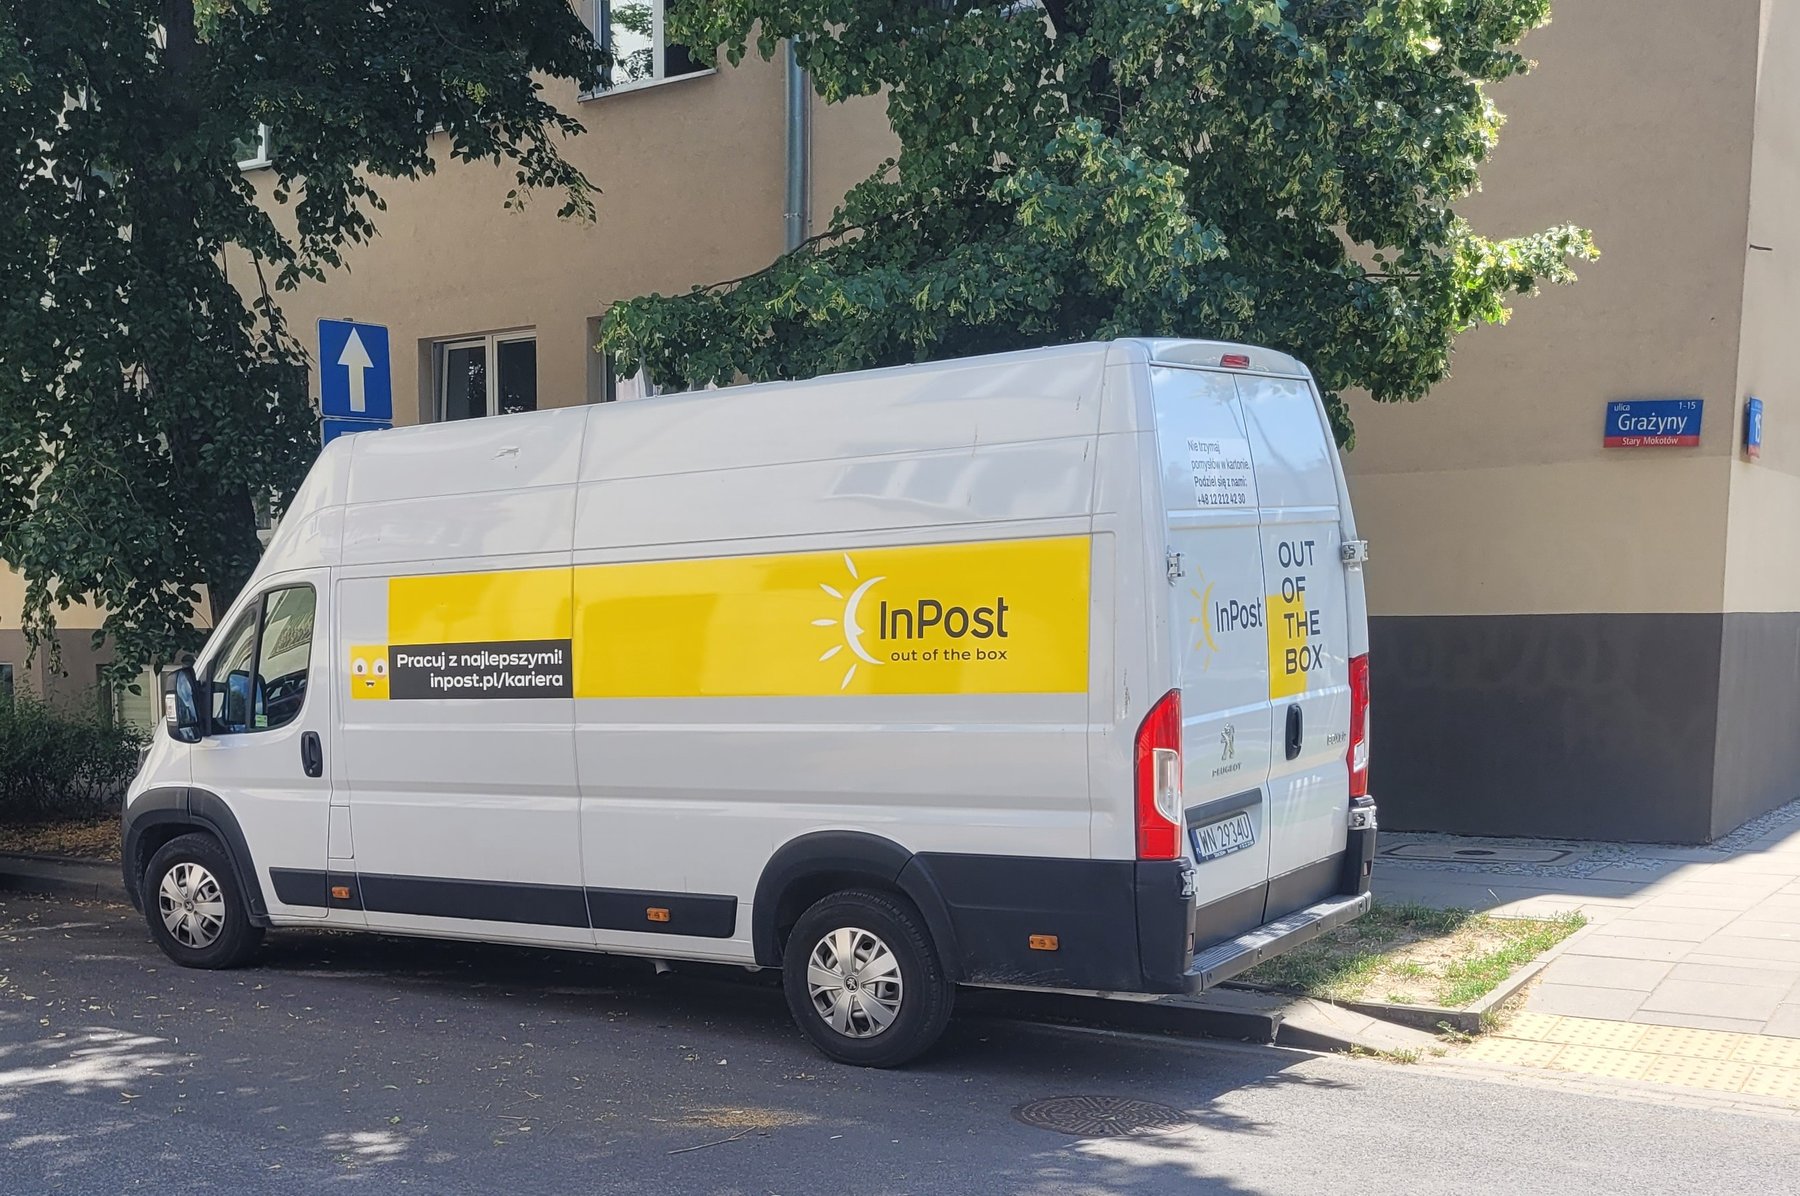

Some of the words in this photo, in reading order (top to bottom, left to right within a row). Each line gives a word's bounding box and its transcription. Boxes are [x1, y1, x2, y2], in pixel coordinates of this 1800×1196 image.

[1614, 403, 1630, 412] ulica
[1679, 401, 1696, 410] 1-15
[1618, 412, 1688, 434] Grażyny
[1622, 437, 1641, 446] Stary
[1643, 436, 1679, 445] Mokotów
[1194, 475, 1217, 487] Podziel
[1210, 493, 1218, 504] 12
[1218, 493, 1230, 504] 212
[1230, 493, 1238, 504] 42
[1238, 493, 1246, 504] 30
[1278, 541, 1315, 568] OUT
[1281, 576, 1306, 603] OF
[880, 597, 1008, 640] InPost
[1215, 597, 1263, 632] InPost
[1283, 609, 1321, 639] THE
[397, 652, 445, 670] Pracuj
[448, 657, 458, 666] z
[461, 649, 563, 669] najlepszymi!
[891, 650, 917, 661] out
[922, 649, 938, 661] of
[943, 649, 971, 660] the
[976, 648, 1007, 660] box
[1285, 643, 1323, 675] BOX
[430, 672, 563, 691] inpost.pl/kariera
[1199, 827, 1217, 853] WN
